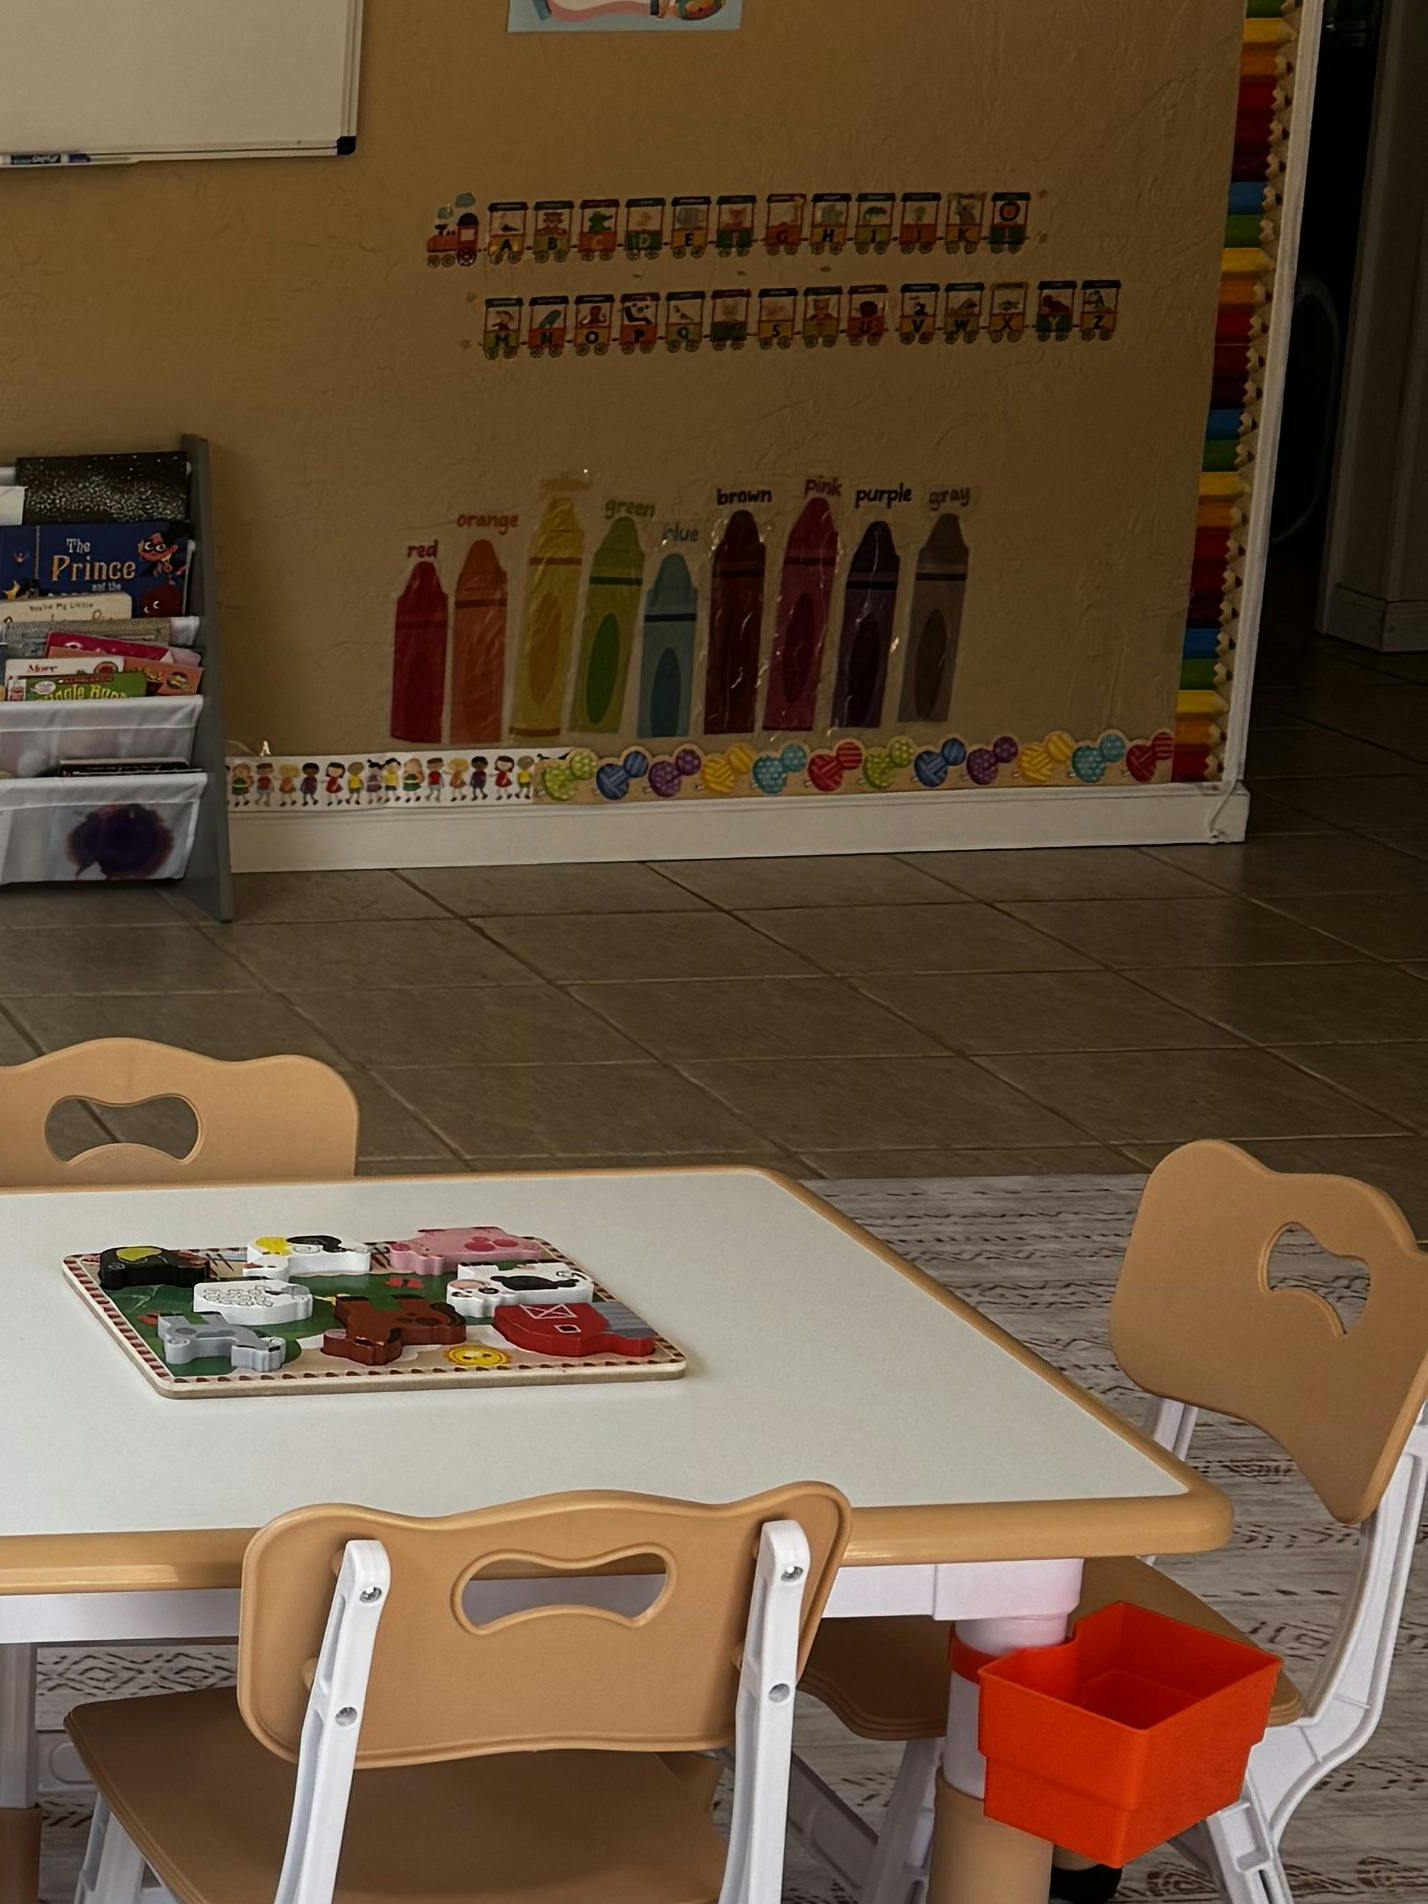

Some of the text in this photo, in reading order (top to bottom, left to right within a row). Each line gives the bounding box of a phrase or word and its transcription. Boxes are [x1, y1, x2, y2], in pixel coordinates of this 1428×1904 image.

[716, 486, 773, 507] brown
[805, 477, 842, 500] pink
[855, 483, 912, 508] purple
[929, 485, 970, 511] gray
[605, 497, 655, 520] green
[456, 510, 519, 535] orange
[67, 538, 90, 554] The
[407, 539, 438, 559] red
[52, 555, 136, 582] Prince
